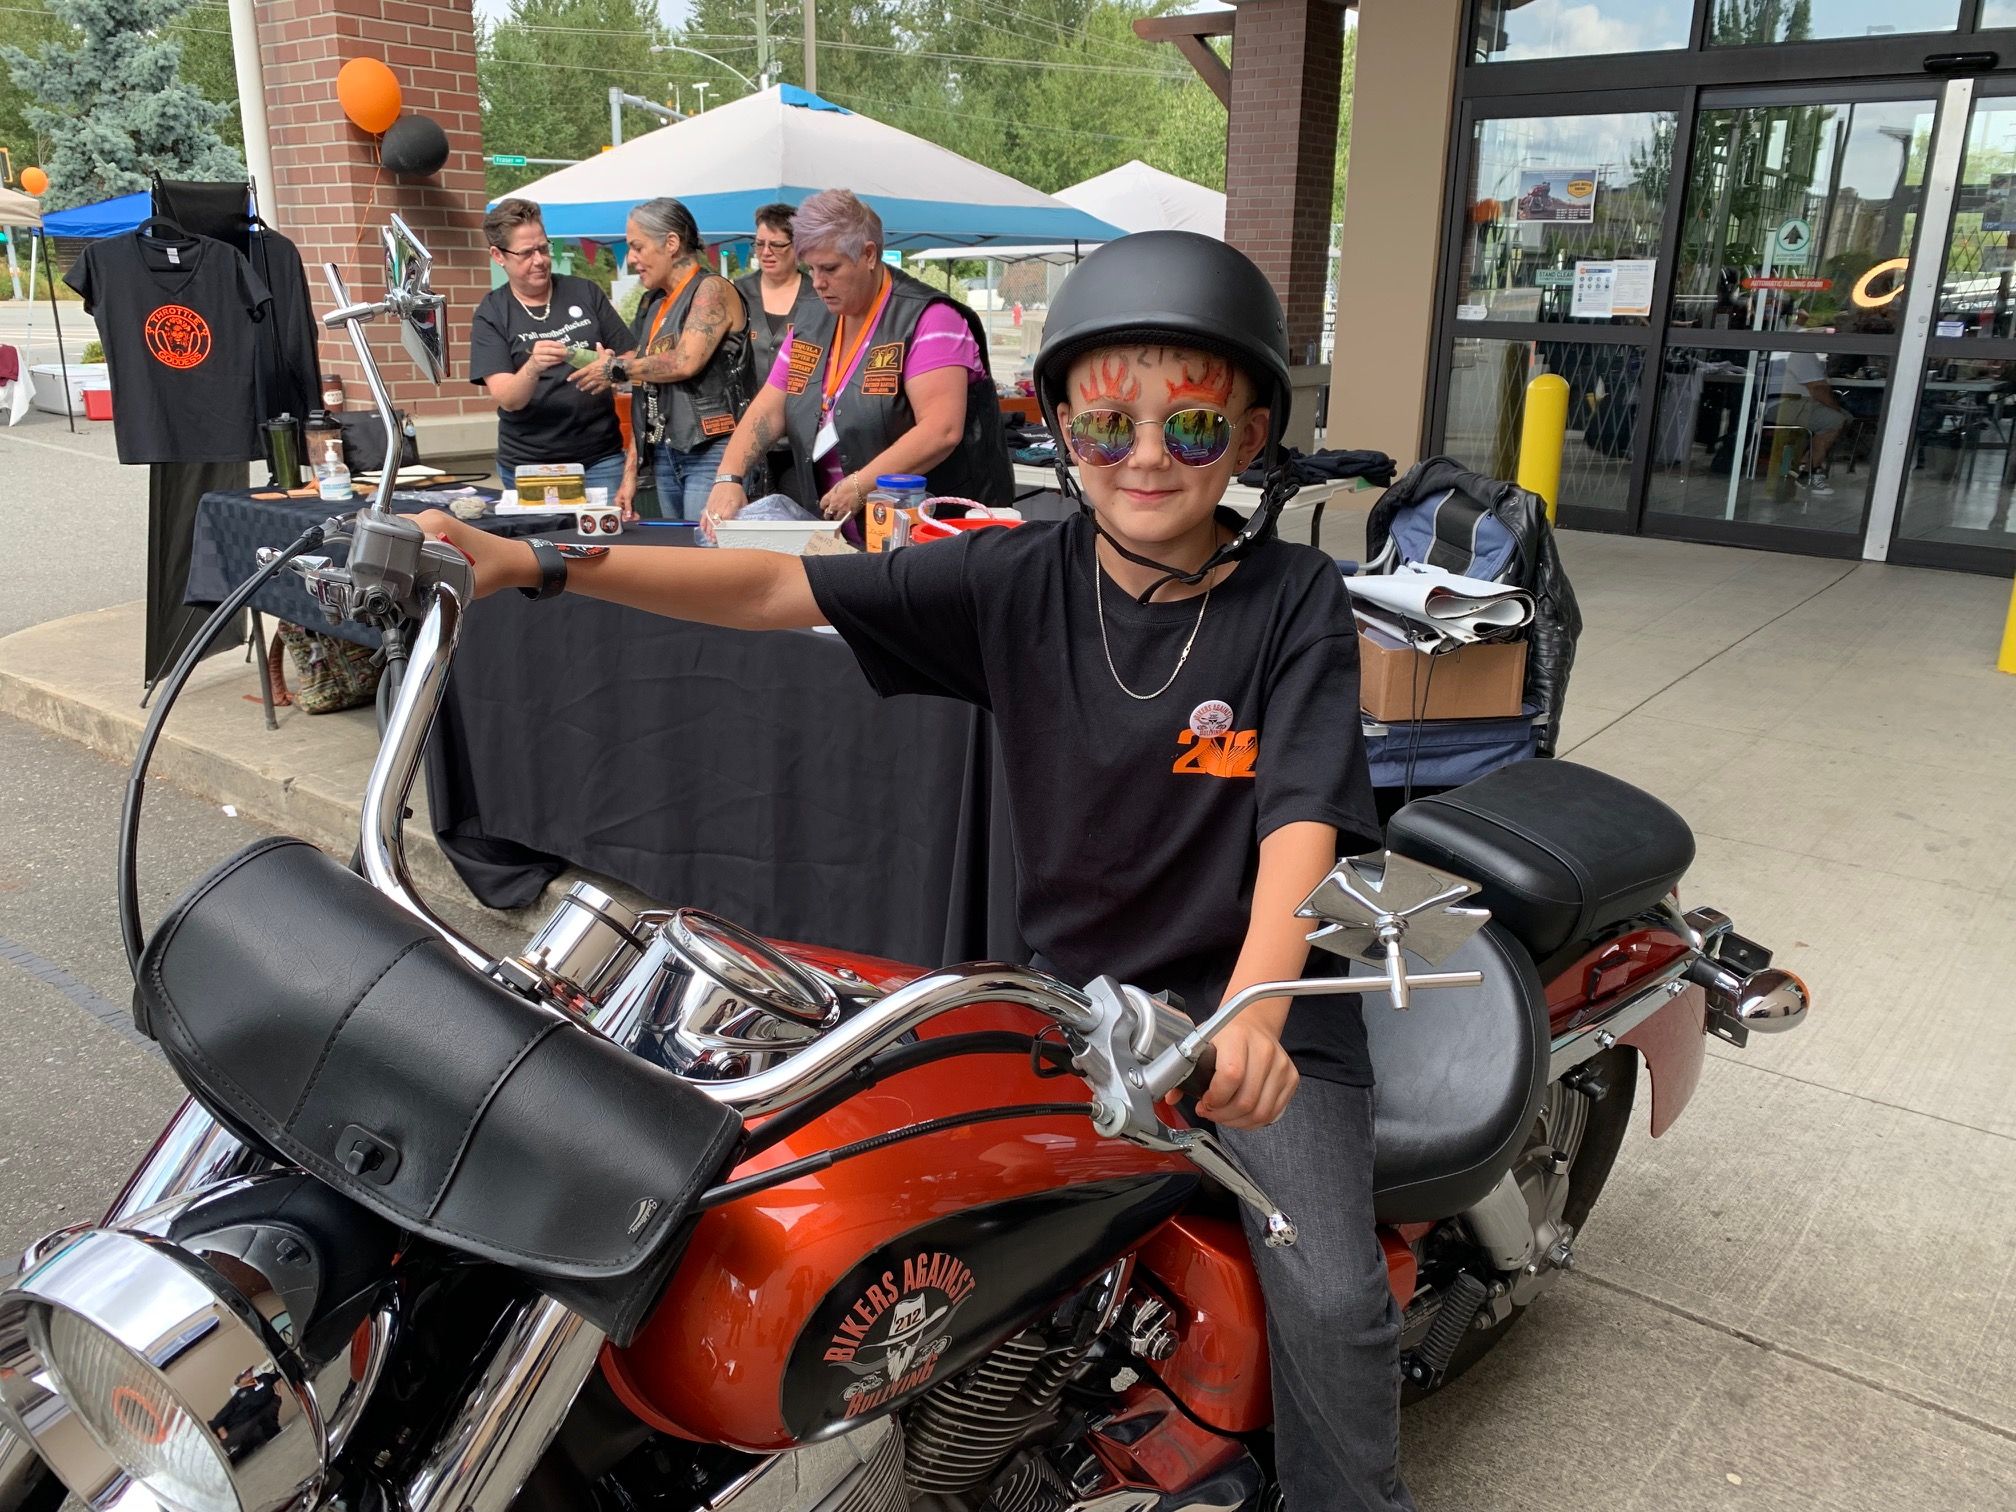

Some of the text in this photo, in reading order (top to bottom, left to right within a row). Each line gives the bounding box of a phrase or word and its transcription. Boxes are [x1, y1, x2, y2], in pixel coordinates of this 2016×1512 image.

[151, 307, 202, 326] THROTTLE
[518, 318, 592, 342] Y'all motherfuckers
[158, 351, 202, 366] GODDESS
[1193, 704, 1213, 721] BIKERS
[823, 1252, 976, 1361] BIKERS AGAINST
[895, 1307, 922, 1332] 212
[844, 1354, 938, 1420] BULLYING
